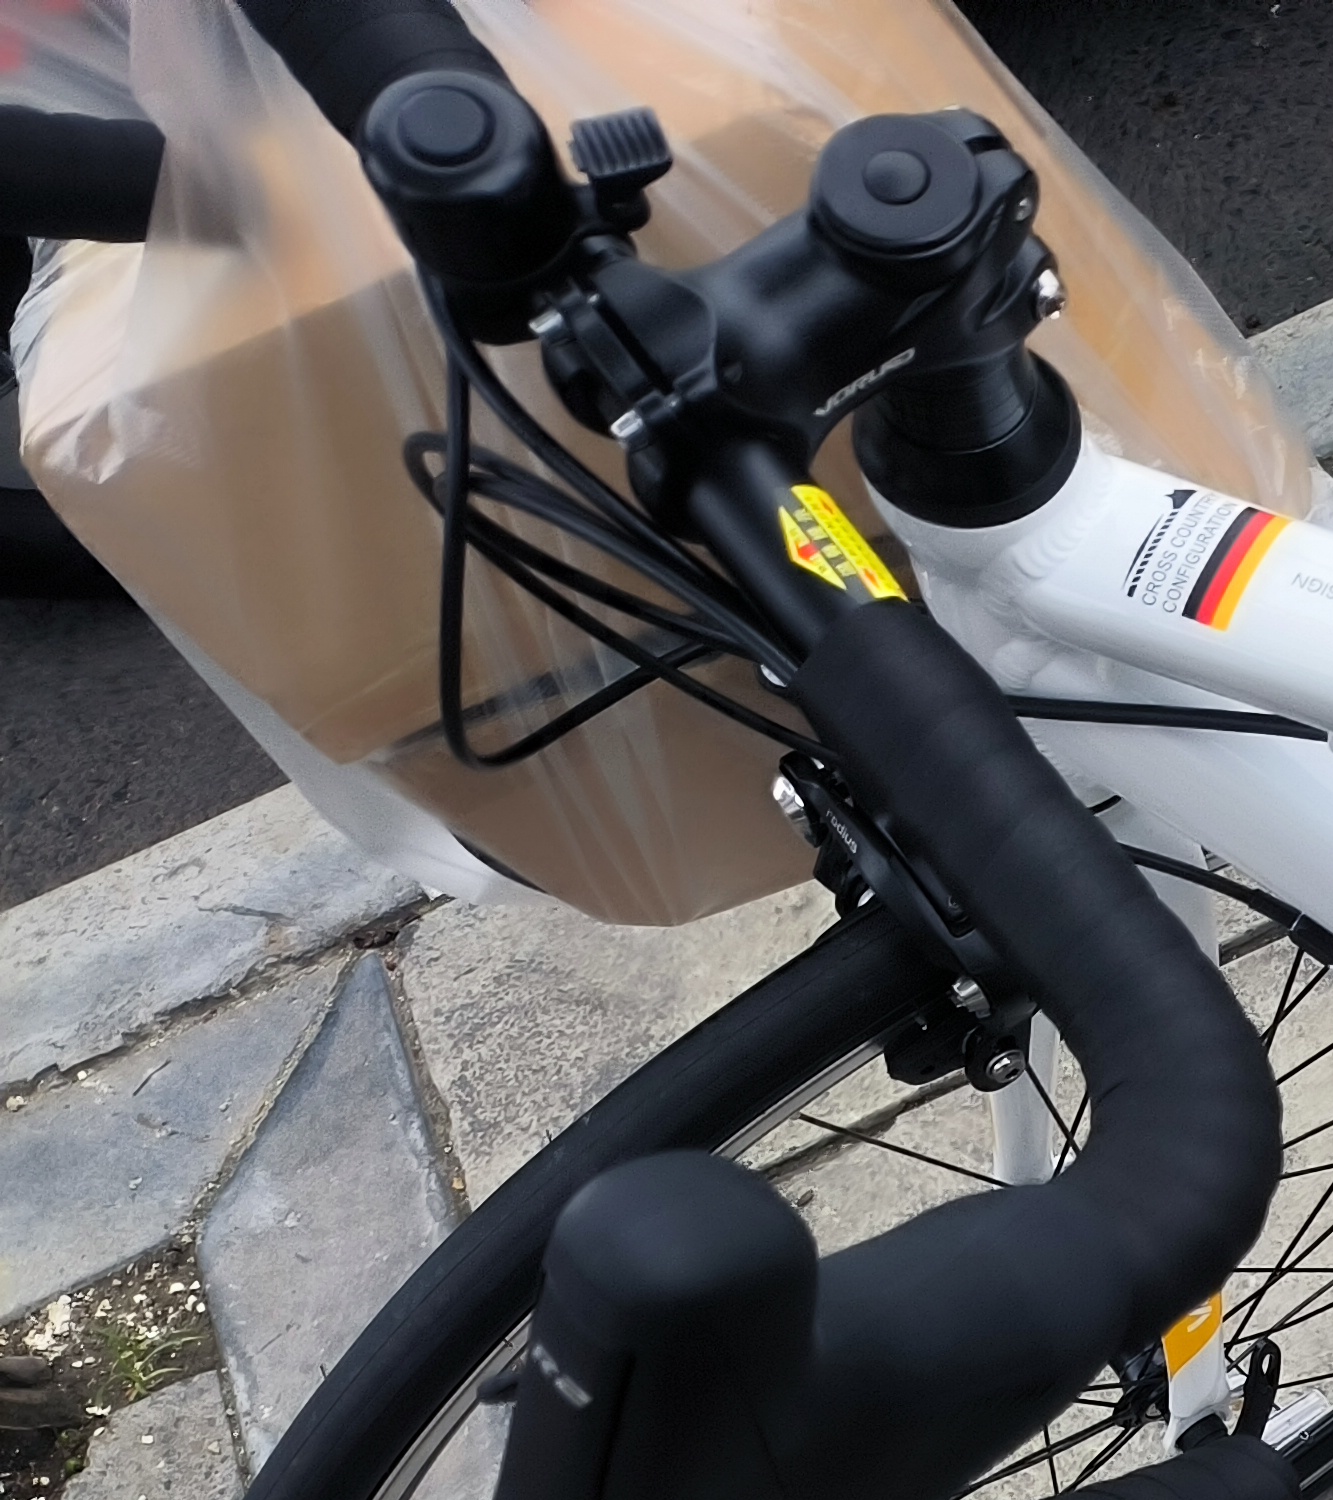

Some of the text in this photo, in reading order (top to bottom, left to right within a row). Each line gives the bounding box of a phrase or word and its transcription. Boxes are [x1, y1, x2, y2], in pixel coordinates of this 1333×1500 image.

[1141, 492, 1218, 606] CROSS COUNTRY
[1162, 499, 1240, 614] CONFIGURATION
[826, 808, 858, 854] radius
